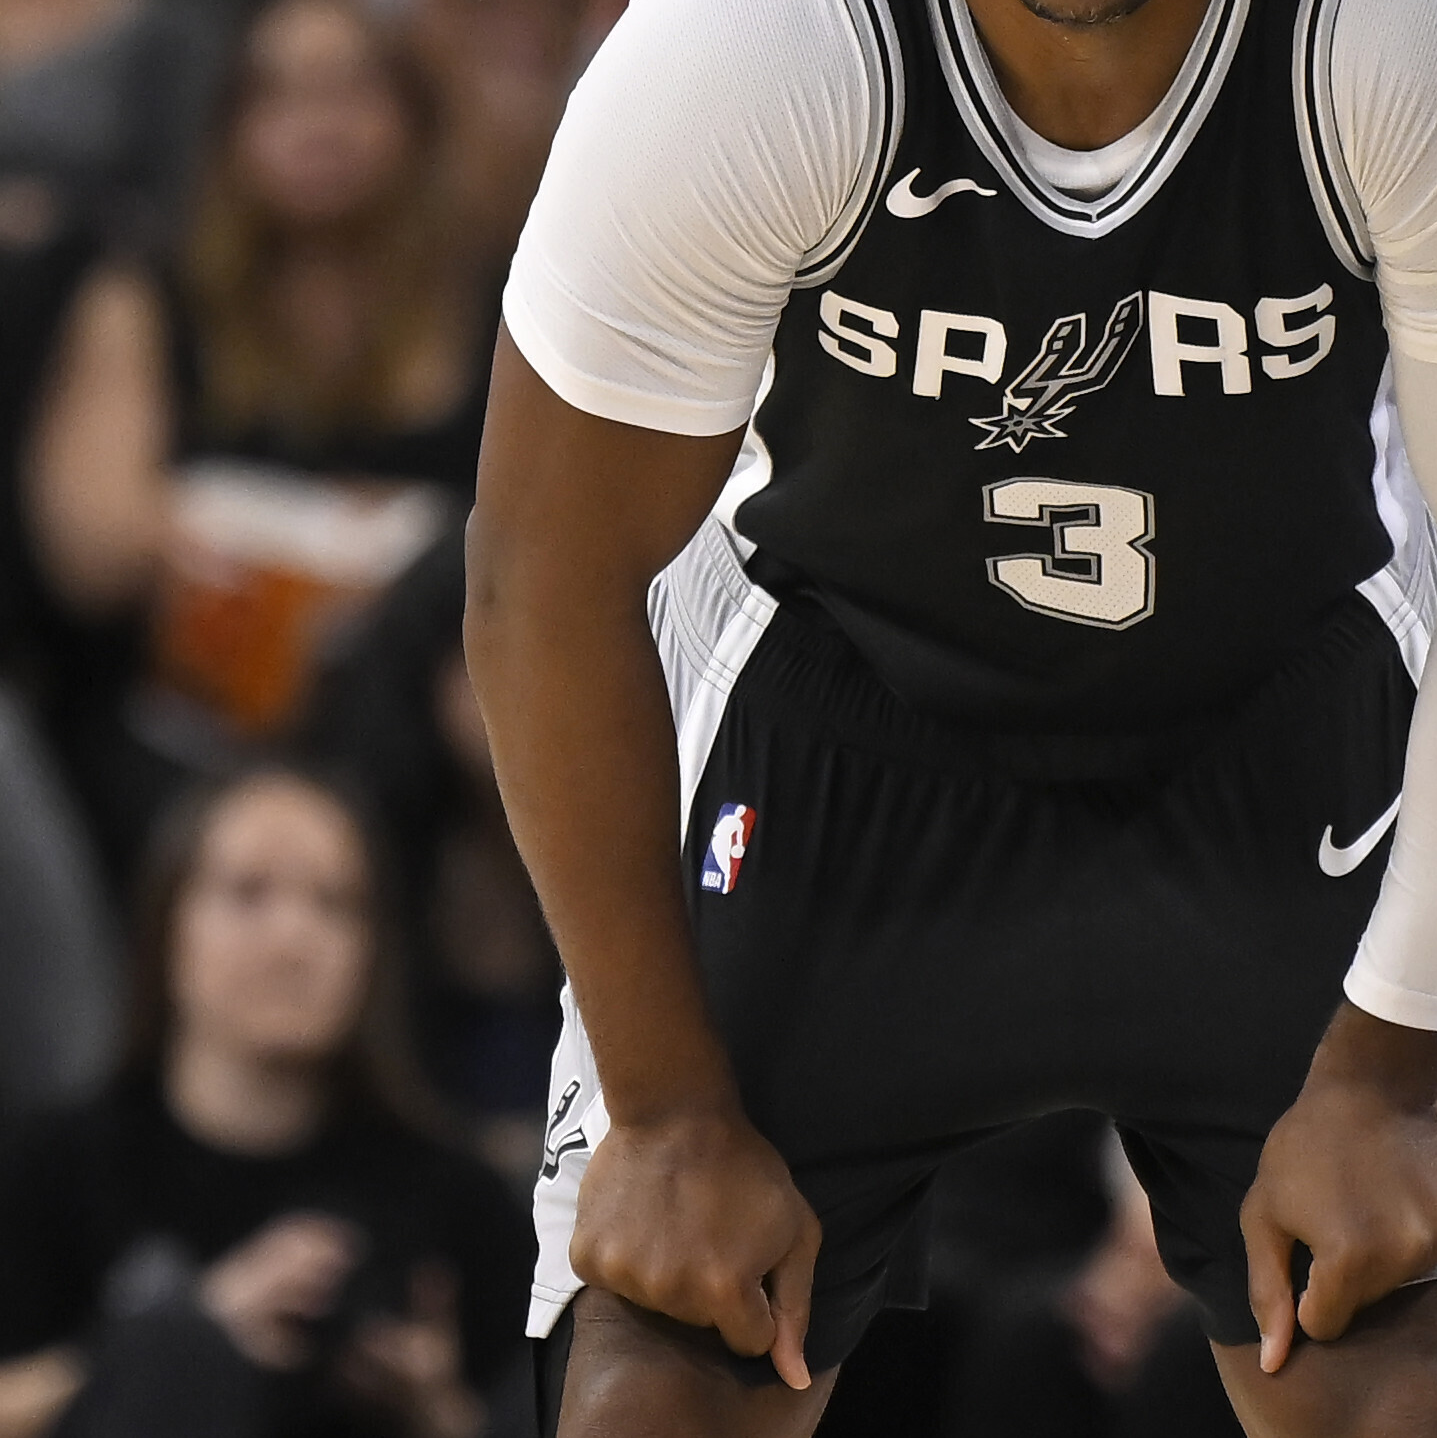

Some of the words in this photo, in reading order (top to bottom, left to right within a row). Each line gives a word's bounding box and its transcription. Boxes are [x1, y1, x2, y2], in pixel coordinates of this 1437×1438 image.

[818, 282, 1336, 454] SPURS
[982, 476, 1156, 631] 3
[701, 870, 722, 889] NBA
